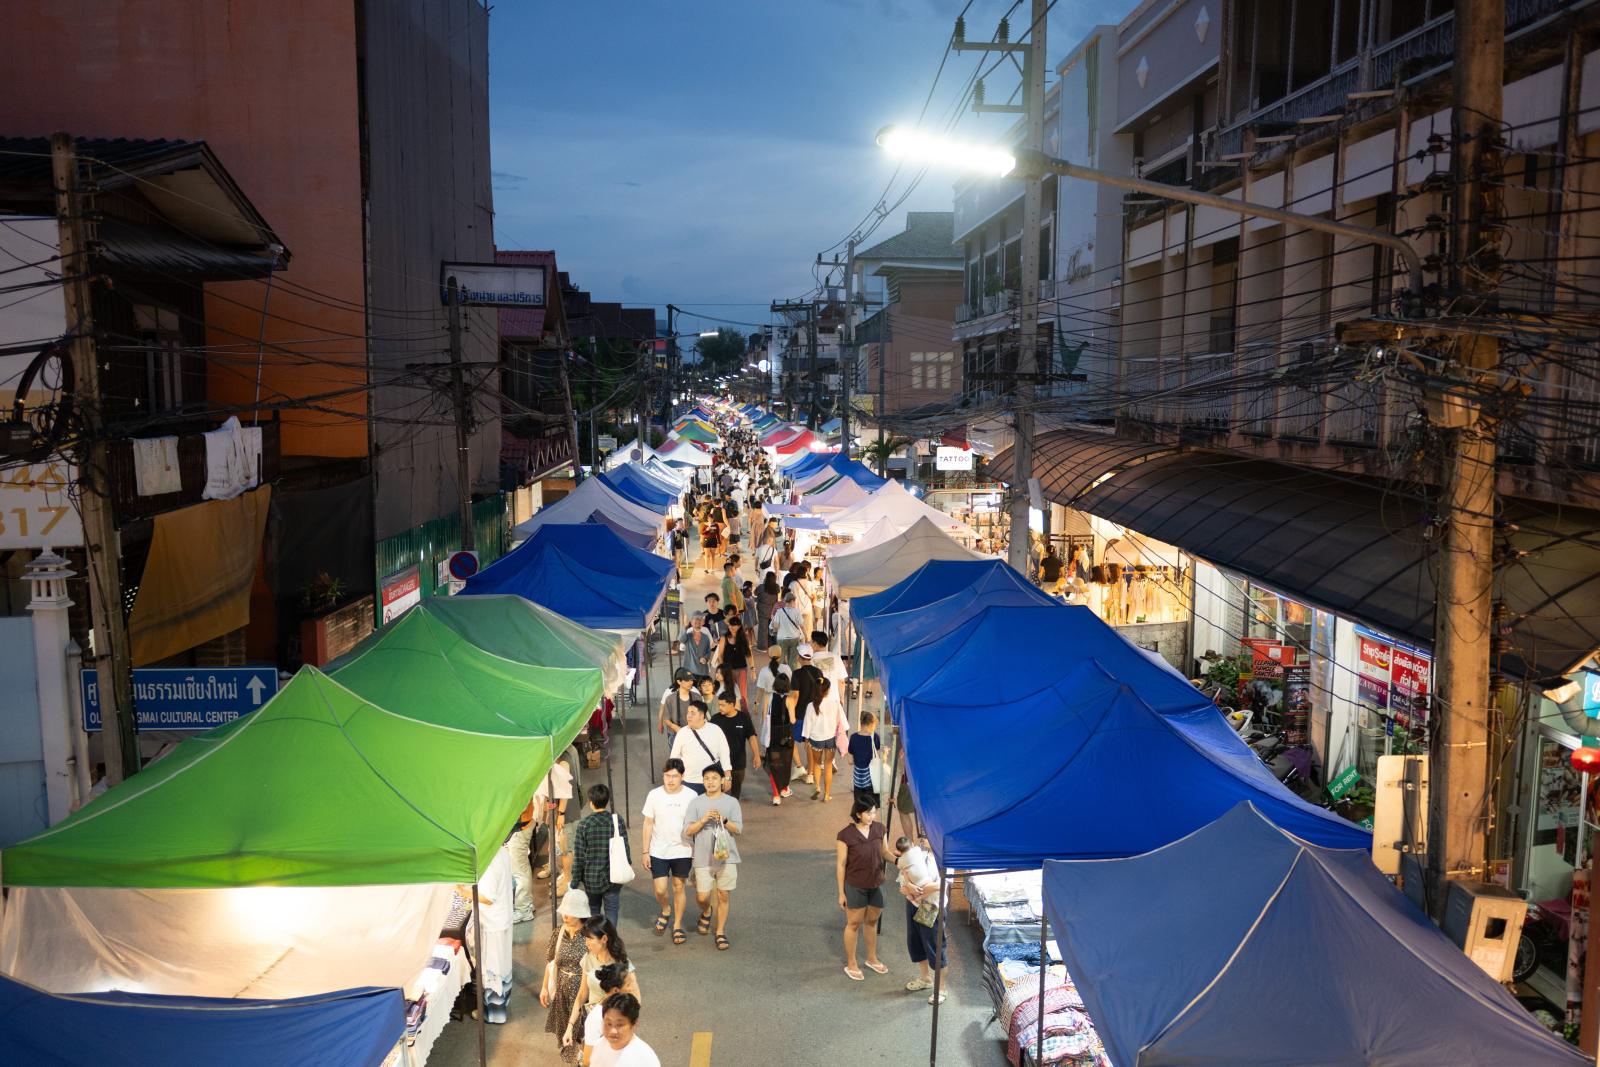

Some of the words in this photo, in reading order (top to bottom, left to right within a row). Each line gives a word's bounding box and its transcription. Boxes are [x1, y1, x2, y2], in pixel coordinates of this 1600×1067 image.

[0, 507, 70, 537] 17
[89, 711, 103, 724] OL
[160, 711, 204, 723] CULTURAL
[1331, 782, 1344, 796] FOR
[1342, 769, 1357, 785] RENT
[1362, 818, 1374, 832] FO
